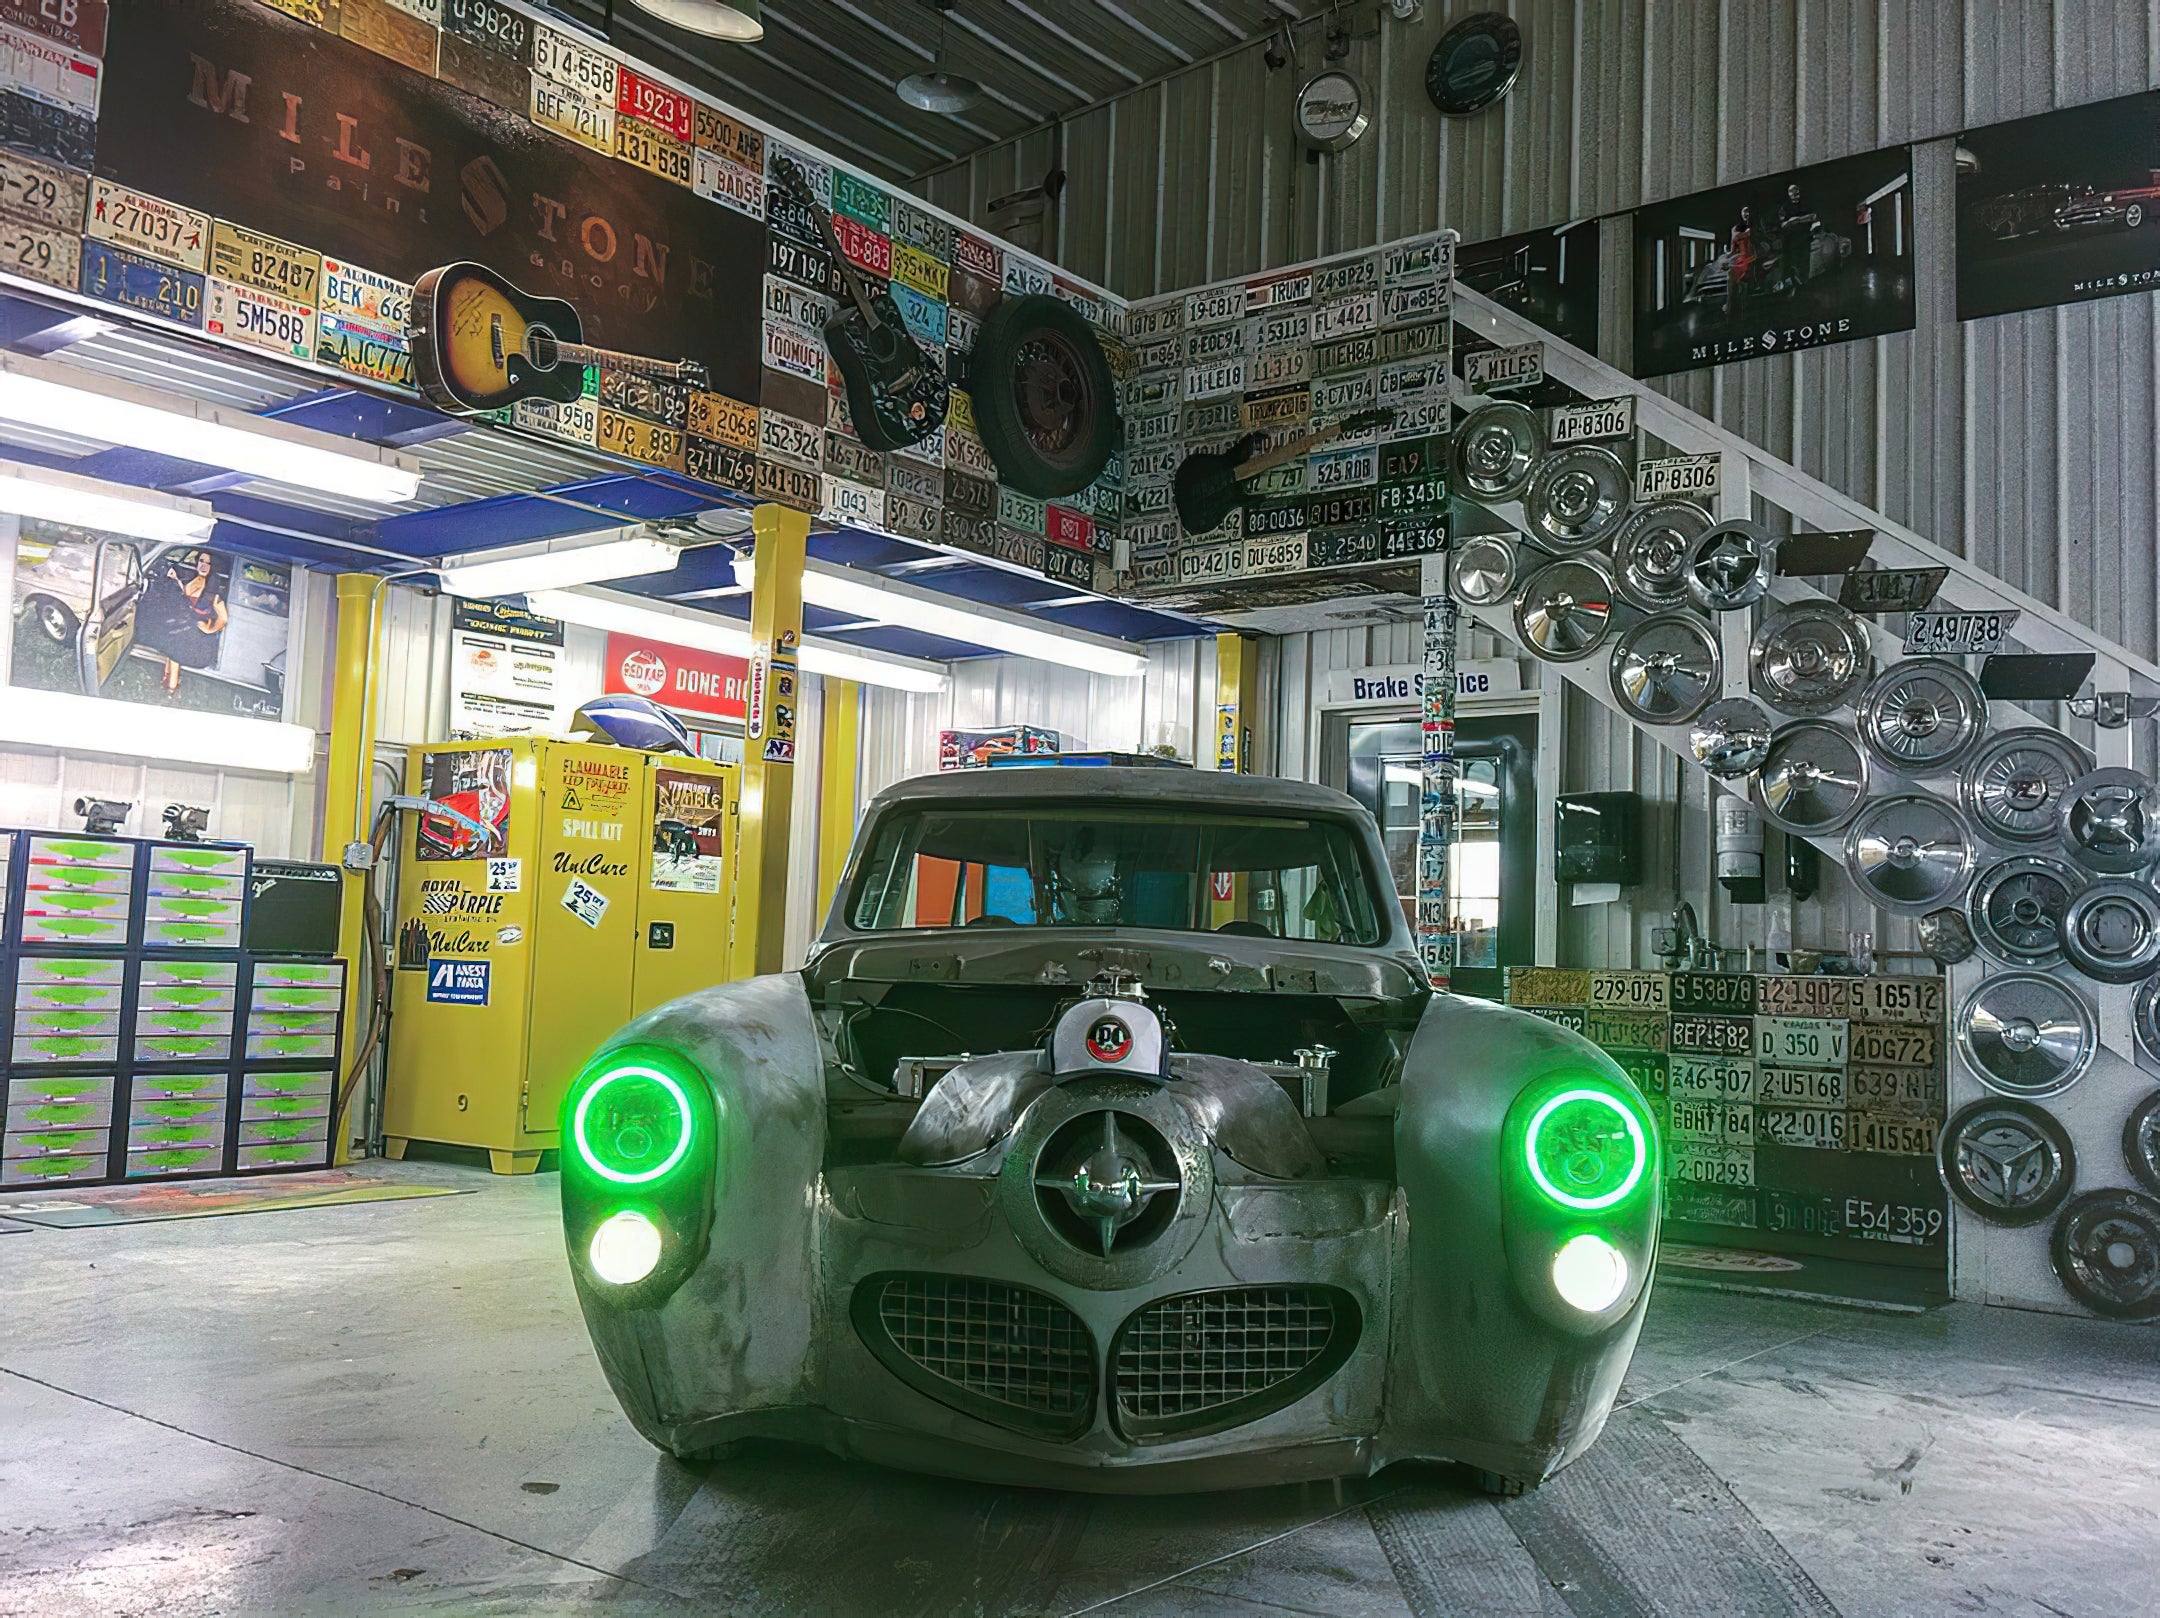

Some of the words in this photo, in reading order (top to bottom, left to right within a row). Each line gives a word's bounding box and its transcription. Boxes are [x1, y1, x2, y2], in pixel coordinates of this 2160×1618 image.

[633, 83, 675, 123] 1923
[571, 104, 608, 143] 7211
[112, 202, 184, 247] 27037
[252, 250, 316, 293] 82487
[771, 240, 796, 273] 197
[801, 253, 826, 284] 196
[158, 276, 199, 311] 210
[327, 275, 363, 309] BEK
[1270, 277, 1310, 304] TRUMP
[236, 300, 304, 345] 5M58B
[1488, 353, 1539, 380] MILES
[717, 409, 757, 439] 2068
[675, 668, 721, 698] DONE
[1354, 675, 1409, 700] Brake
[1414, 672, 1489, 697] Sice
[562, 817, 599, 840] SPILL
[553, 851, 628, 876] UniCure
[430, 929, 490, 954] UniCure
[1875, 982, 1938, 1011] 16512
